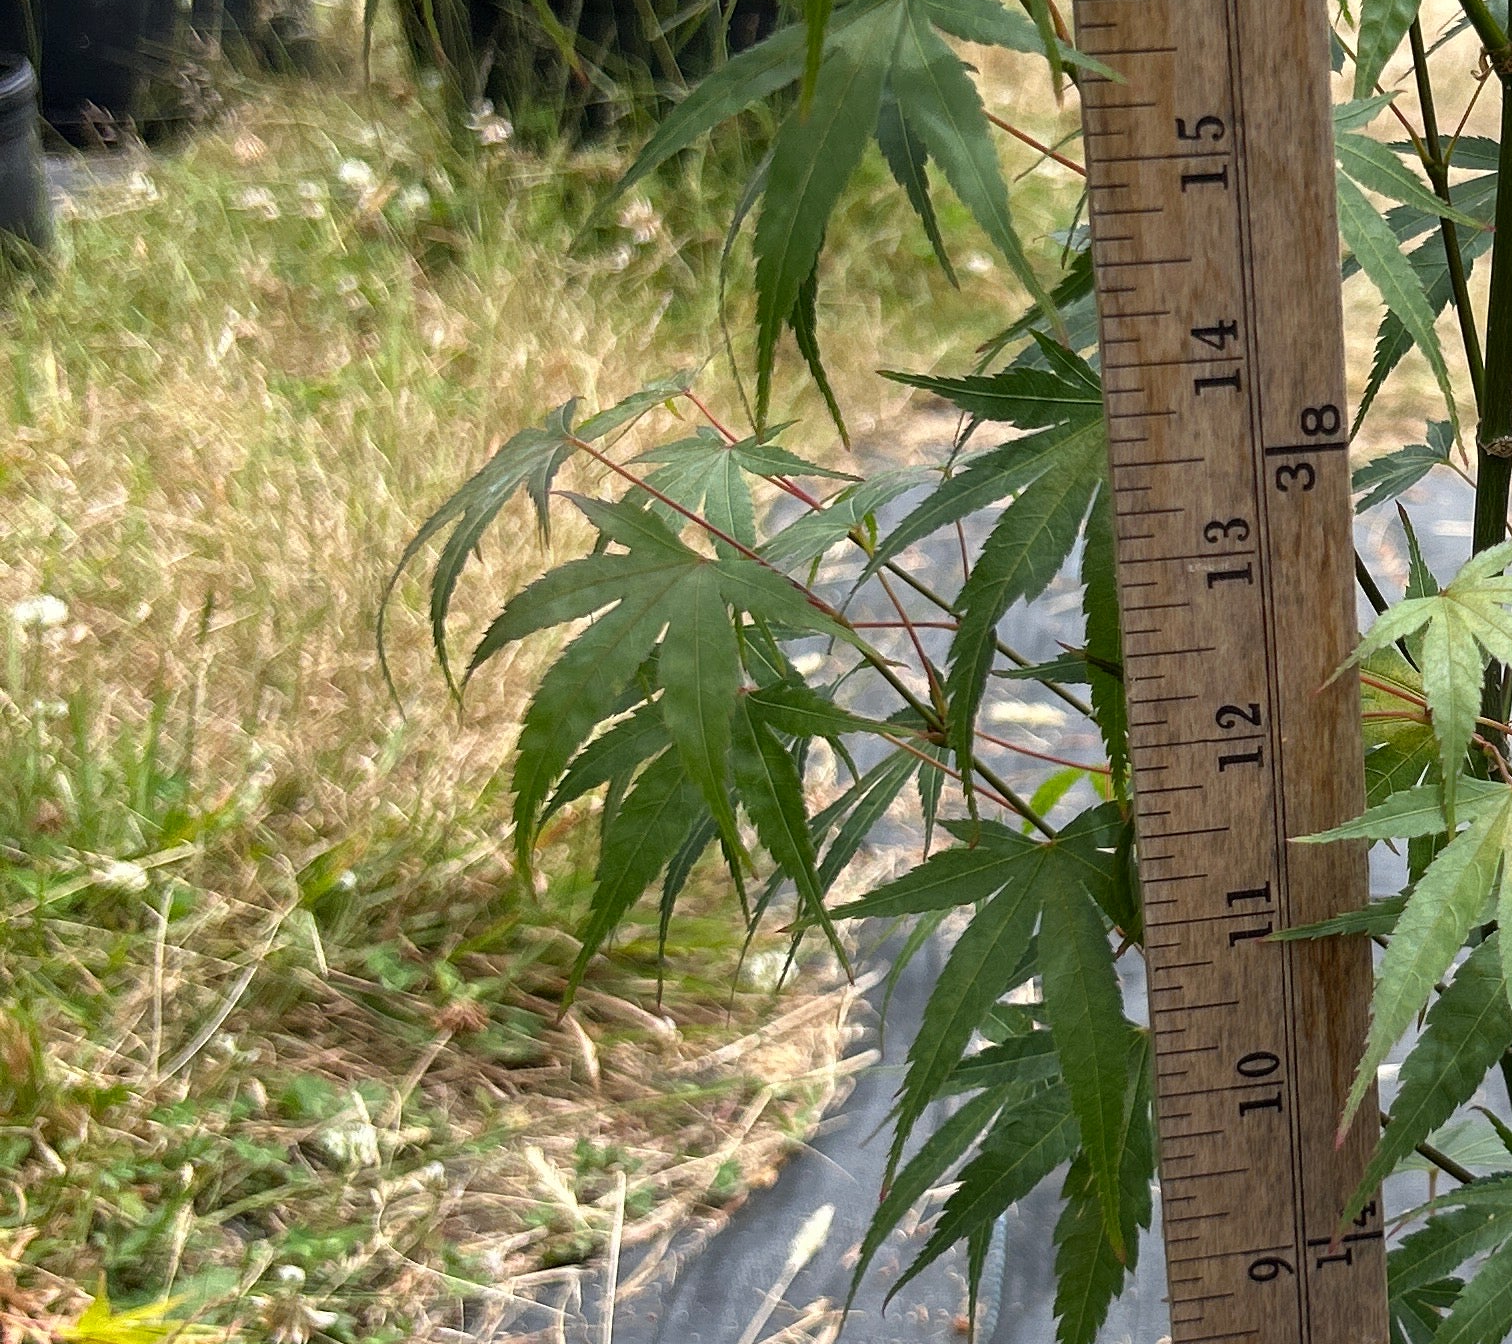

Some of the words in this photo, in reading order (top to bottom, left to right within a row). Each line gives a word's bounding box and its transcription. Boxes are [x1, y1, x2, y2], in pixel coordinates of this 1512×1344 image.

[1175, 114, 1230, 193] 15
[1190, 319, 1241, 398] 14
[1203, 516, 1253, 590] 13
[1215, 702, 1264, 774] 12
[1226, 880, 1273, 947] 11
[1236, 1051, 1283, 1117] 10
[1249, 1256, 1294, 1282] 9
